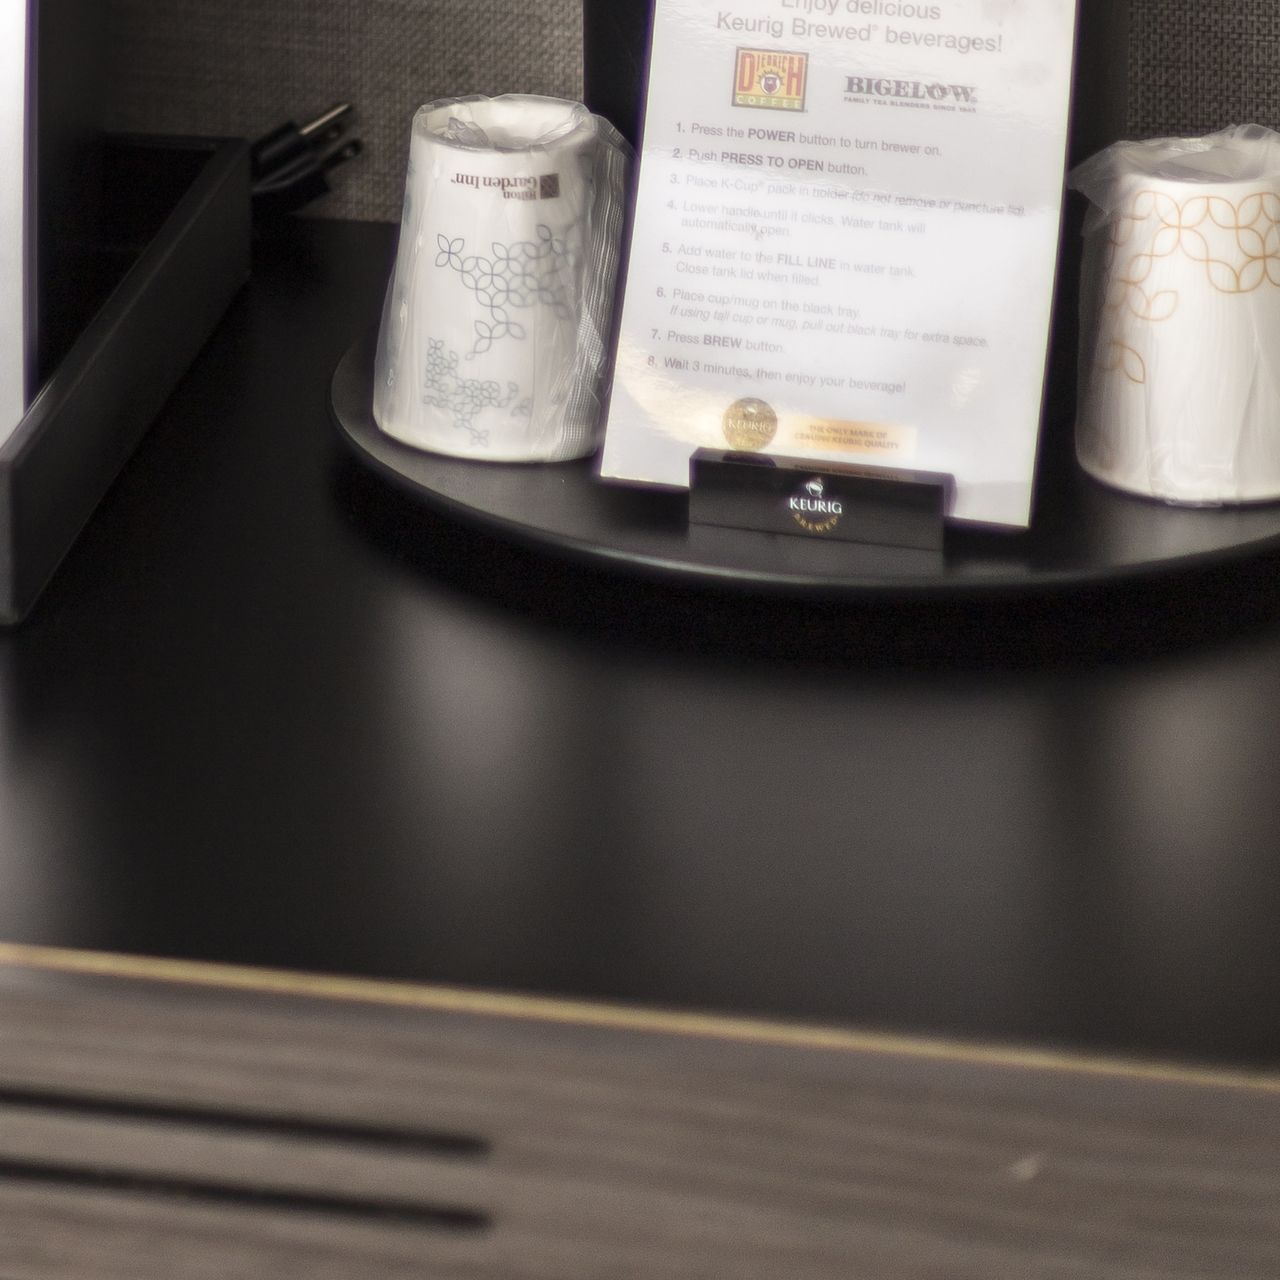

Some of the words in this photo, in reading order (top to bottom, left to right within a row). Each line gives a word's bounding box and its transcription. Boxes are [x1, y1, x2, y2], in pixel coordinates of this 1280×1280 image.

[716, 11, 784, 38] Keurig
[885, 25, 1003, 54] beverages!
[736, 95, 801, 109] COFFEE
[843, 75, 976, 102] BIGELOW
[676, 123, 685, 133] 1.
[691, 123, 723, 137] Press
[726, 126, 744, 137] the
[747, 128, 795, 143] POWER
[799, 133, 836, 146] button
[840, 136, 851, 147] to
[855, 138, 877, 150] turn
[881, 140, 920, 154] brewer
[924, 144, 942, 156] on.
[672, 148, 683, 159] 2.
[688, 148, 717, 161] Push
[721, 151, 763, 166] PRESS
[768, 155, 784, 168] TO
[788, 157, 824, 172] OPEN
[827, 162, 868, 176] button.
[669, 174, 680, 185] 3.
[686, 174, 717, 189] Place
[767, 183, 795, 197] pack
[799, 186, 809, 197] in
[666, 200, 677, 210] 4.
[683, 200, 719, 214] Lower
[763, 208, 788, 221] until
[841, 215, 874, 229] Water
[877, 219, 904, 232] tank
[906, 221, 926, 233] will
[662, 242, 672, 254] 5.
[677, 243, 701, 257] Add
[705, 248, 736, 260] water
[740, 250, 751, 262] to
[755, 251, 773, 264] the
[777, 253, 803, 267] FILL
[807, 256, 836, 270] LINE
[840, 260, 850, 271] in
[853, 263, 885, 275] water
[676, 261, 709, 275] Close
[712, 265, 737, 278] tank
[740, 268, 753, 280] lid
[757, 270, 788, 284] when
[656, 286, 667, 299] 6.
[672, 288, 705, 302] Place
[707, 293, 760, 310] cup/mug
[762, 298, 777, 309] on
[781, 299, 799, 312] the
[803, 302, 833, 316] black
[651, 328, 661, 340] 7.
[667, 330, 699, 344] Press
[703, 334, 742, 348] BREW
[680, 307, 710, 322] using
[713, 311, 730, 323] tall
[732, 313, 753, 326] cup
[756, 316, 770, 326] or
[801, 319, 823, 331] pull
[826, 322, 844, 333] out
[847, 323, 876, 337] black
[880, 326, 900, 341] tray
[904, 328, 919, 341] for
[664, 355, 690, 370] Wait
[692, 360, 700, 372] 3
[703, 362, 753, 380] minutes,
[756, 367, 782, 380] then
[785, 371, 817, 387] enjoy
[820, 375, 846, 389] your
[849, 377, 906, 395] beverage!
[789, 497, 842, 514] KEURIG
